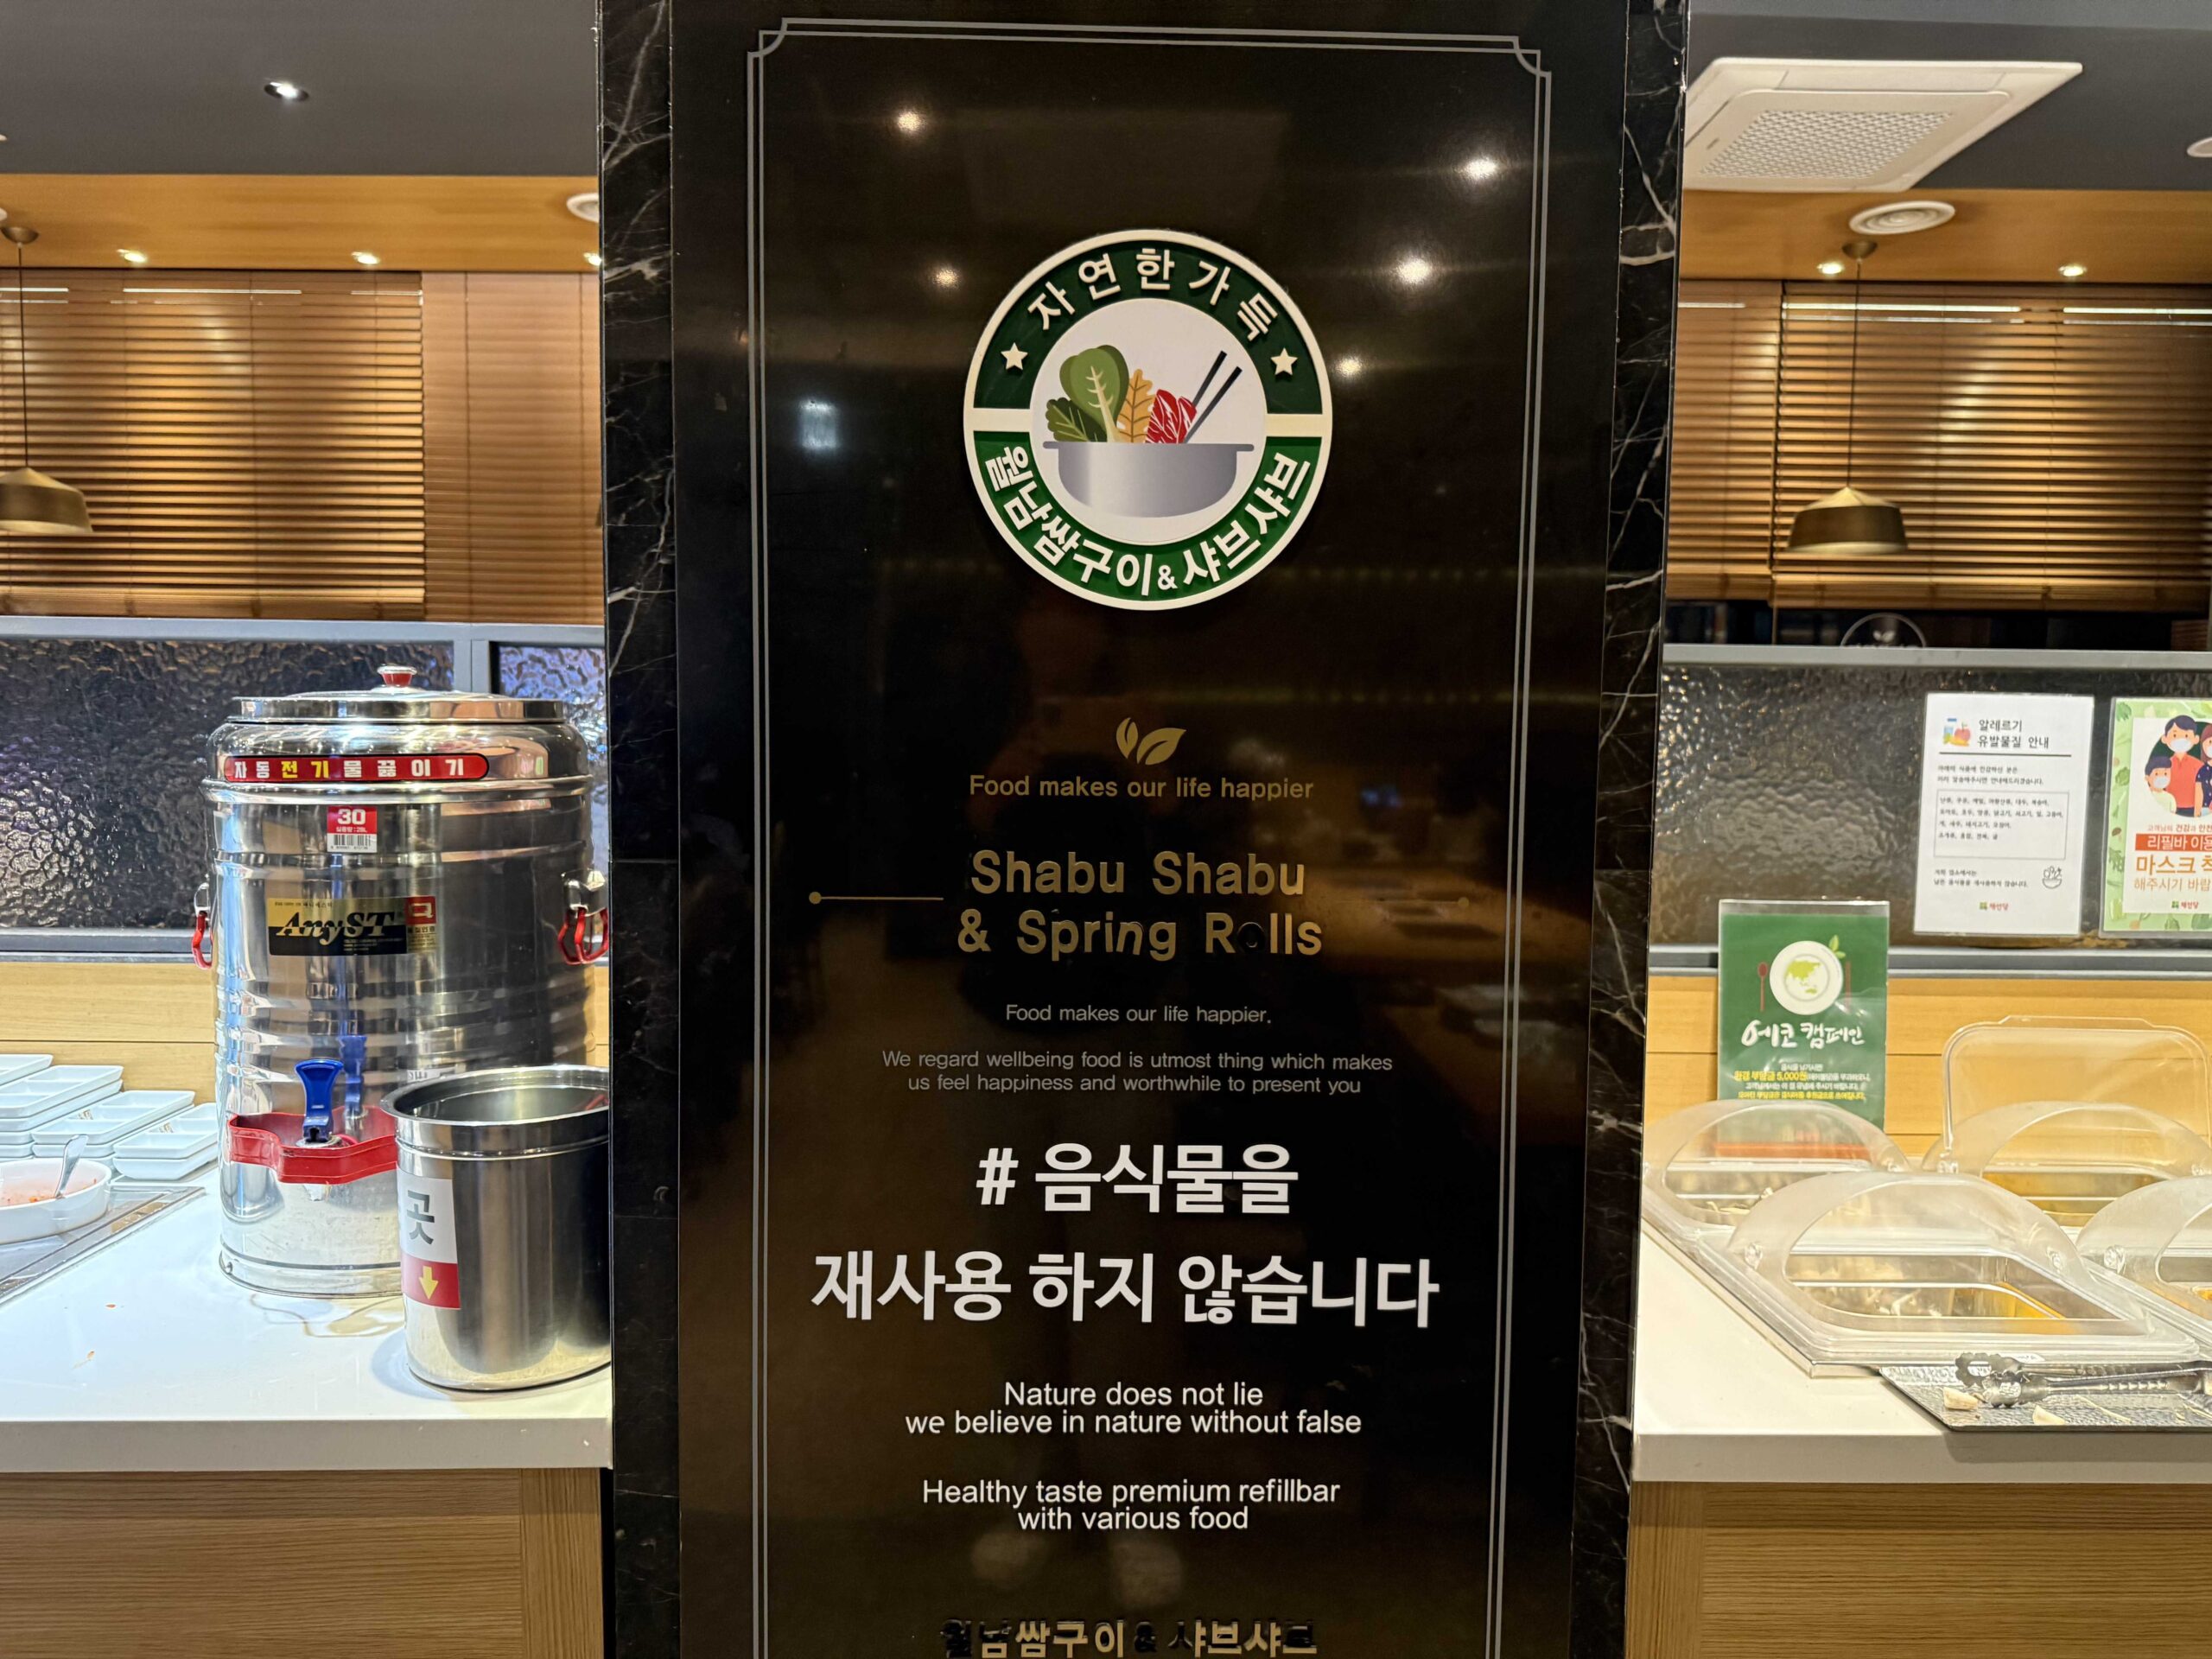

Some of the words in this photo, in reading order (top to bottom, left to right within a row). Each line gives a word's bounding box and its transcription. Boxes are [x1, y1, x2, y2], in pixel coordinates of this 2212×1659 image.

[1027, 247, 1280, 341] 자연한가득
[1979, 719, 2022, 732] 알레르기
[1977, 734, 2021, 748] 유발물질
[2028, 736, 2050, 749] 안내
[969, 774, 1030, 796] Food
[1039, 776, 1118, 798] makes
[1127, 781, 1167, 798] our
[1176, 777, 1211, 798] life
[1221, 777, 1314, 801] happier
[337, 809, 365, 825] 30
[2147, 835, 2187, 850] 리필바
[970, 849, 1125, 894] Shabu
[1152, 850, 1305, 896] Shabu
[2136, 854, 2196, 875] 마스크
[2134, 878, 2183, 892] 해주시기
[276, 912, 396, 946] AnyST
[957, 908, 991, 953] &
[1016, 908, 1177, 962] Spring
[1006, 1004, 1052, 1021] Food
[1059, 1004, 1120, 1021] makes
[1126, 1008, 1158, 1022] our
[1164, 1005, 1189, 1022] life
[1196, 1005, 1272, 1025] happier.
[1741, 1020, 1798, 1048] 에코
[1800, 1022, 1866, 1049] 캠페인
[882, 1050, 911, 1067] We
[918, 1050, 979, 1070] regard
[986, 1051, 1074, 1071] wellbeing
[1081, 1051, 1122, 1068] food
[1129, 1052, 1144, 1068] is
[1150, 1052, 1211, 1069] utmost
[1217, 1052, 1264, 1071] thing
[1270, 1052, 1325, 1070] which
[1332, 1053, 1393, 1071] makes
[908, 1077, 931, 1090] us
[938, 1073, 969, 1090] feel
[977, 1073, 1073, 1093] happiness
[1080, 1074, 1116, 1091] and
[1122, 1074, 1222, 1092] worthwhile
[1227, 1076, 1246, 1092] to
[1252, 1077, 1321, 1095] present
[1327, 1080, 1361, 1096] you
[976, 1147, 1020, 1205] #
[1034, 1142, 1300, 1214] 음식물을
[406, 1190, 435, 1245] 곳
[810, 1249, 1012, 1322] 재사용
[1028, 1251, 1154, 1324] 하지
[1178, 1254, 1440, 1329] 않습니다
[1005, 1381, 1096, 1407] Nature
[1105, 1381, 1173, 1407] does
[1182, 1382, 1225, 1407] not
[1233, 1381, 1264, 1407] lie
[905, 1415, 945, 1434] we
[955, 1409, 1052, 1434] believe
[1062, 1408, 1084, 1433] in
[1095, 1410, 1182, 1433] nature
[1190, 1408, 1289, 1433] without
[1296, 1408, 1362, 1434] false
[923, 1478, 1028, 1510] Healthy
[1035, 1479, 1103, 1503] taste
[1112, 1478, 1230, 1510] premium
[1238, 1478, 1341, 1503] refillbar
[1017, 1505, 1072, 1530] with
[1081, 1505, 1181, 1530] various
[1188, 1505, 1249, 1530] food
